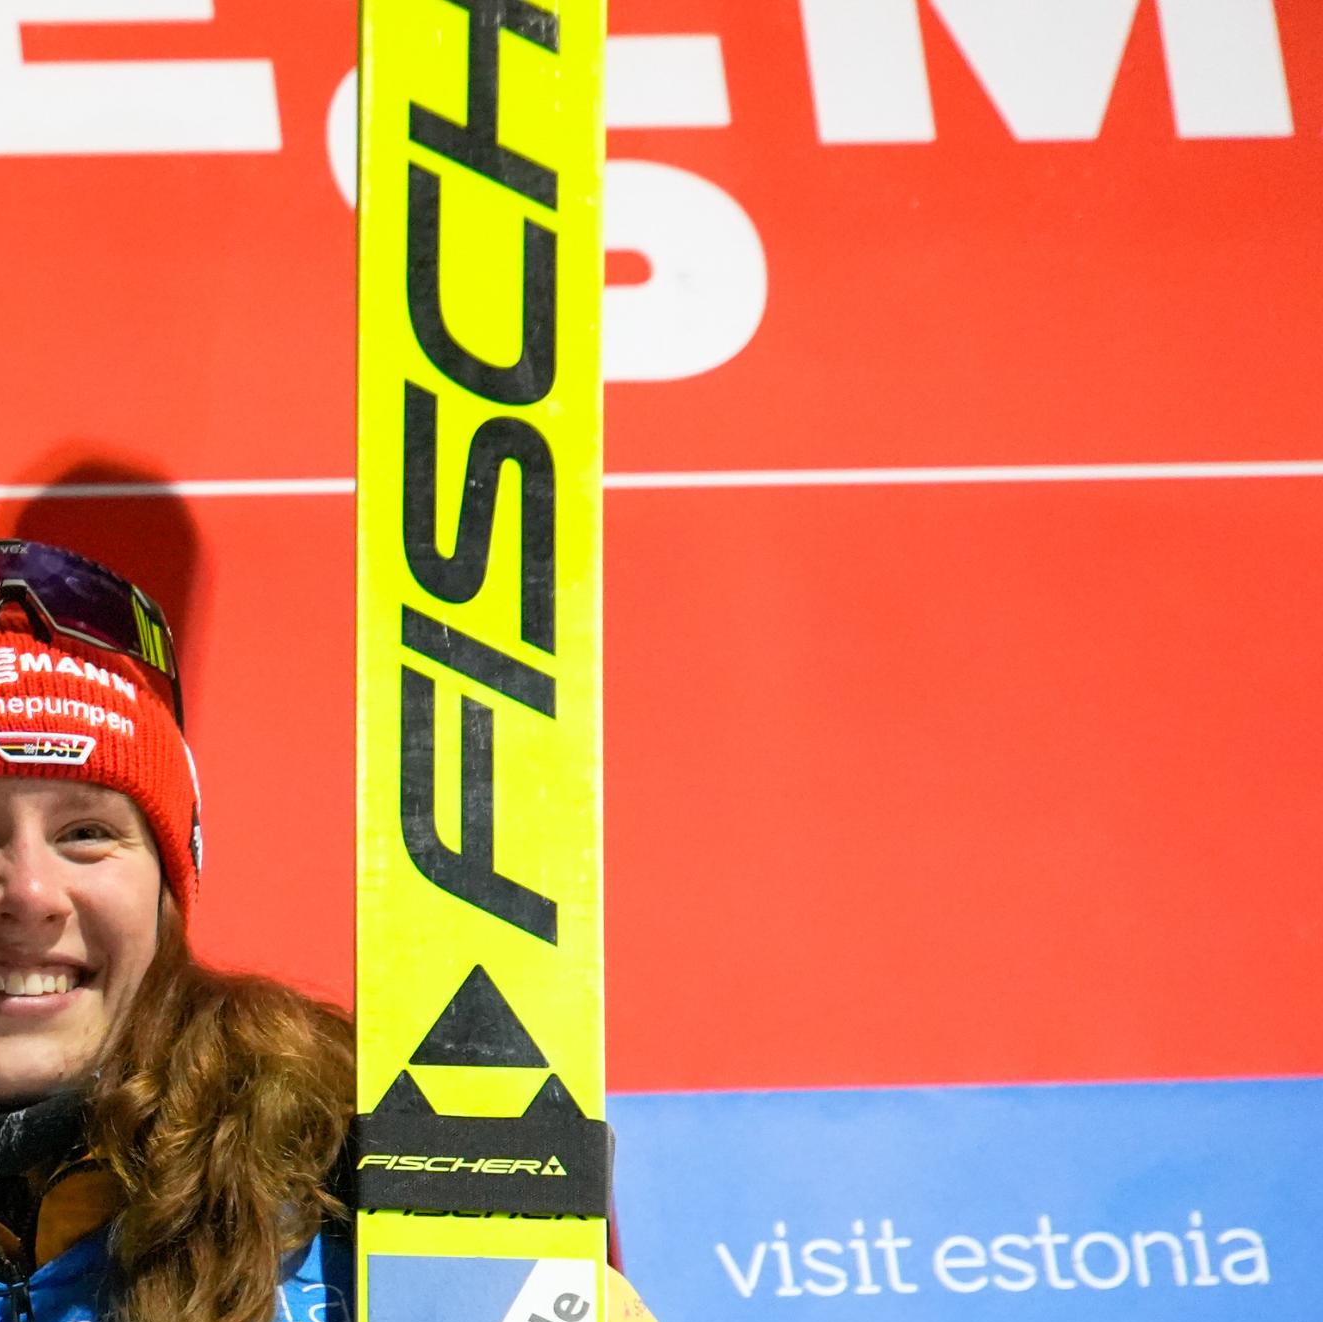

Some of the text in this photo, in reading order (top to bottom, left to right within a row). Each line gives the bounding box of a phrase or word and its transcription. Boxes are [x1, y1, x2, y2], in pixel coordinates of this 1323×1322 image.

[356, 1154, 543, 1176] FISCHER
[715, 1210, 1272, 1299] visit estonia
